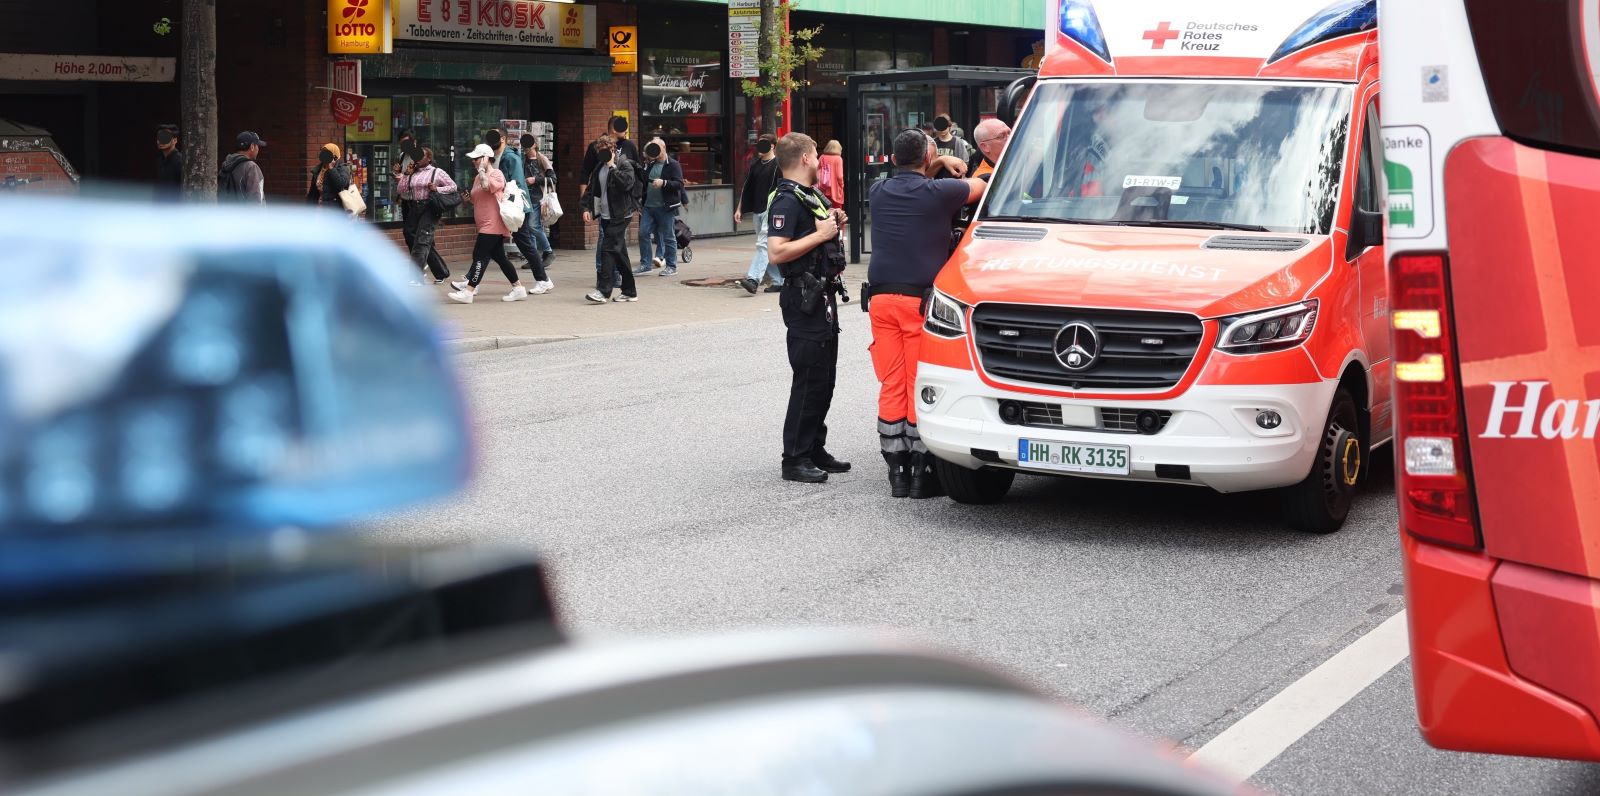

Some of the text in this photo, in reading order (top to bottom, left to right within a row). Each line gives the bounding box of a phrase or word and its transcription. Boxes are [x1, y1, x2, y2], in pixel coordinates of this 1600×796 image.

[477, 0, 546, 29] KIOSK
[335, 23, 376, 36] LOTTO
[562, 27, 581, 37] LOTTO
[1186, 21, 1258, 32] Deutsches
[408, 24, 554, 44] Tabakwaren Zeitschriften Getränke
[1183, 31, 1223, 41] Rotes
[340, 40, 370, 48] Hamburg
[1180, 41, 1221, 51] Kreuz
[665, 56, 700, 64] ALLWÖRDEN
[54, 61, 122, 76] Höhe 2,00m
[981, 256, 1227, 282] RETTUNGSDIENST
[1029, 443, 1127, 468] HH RK 3135
